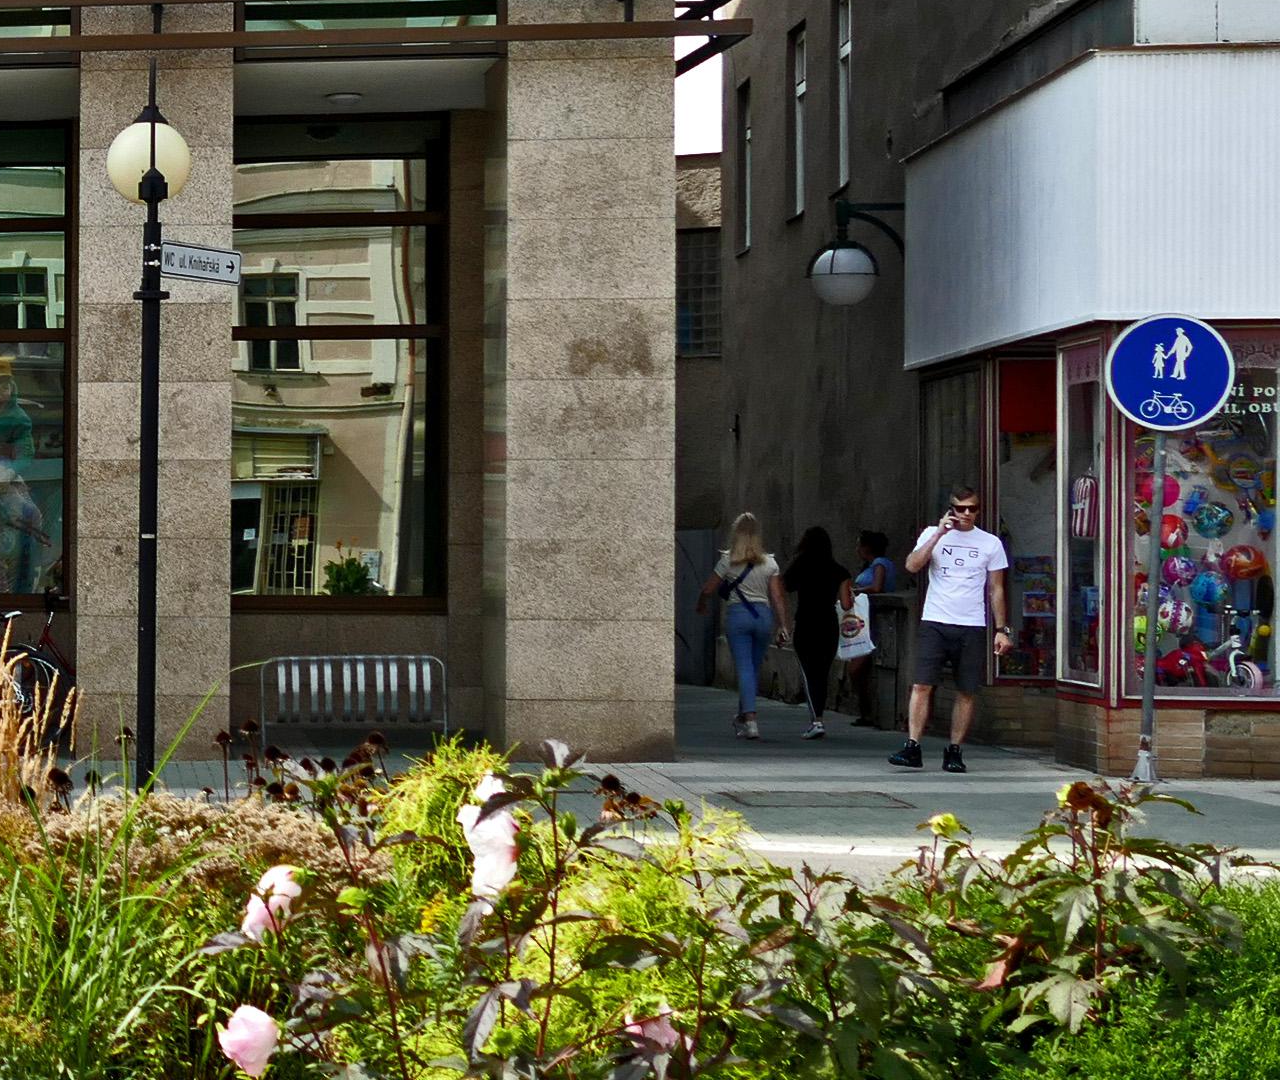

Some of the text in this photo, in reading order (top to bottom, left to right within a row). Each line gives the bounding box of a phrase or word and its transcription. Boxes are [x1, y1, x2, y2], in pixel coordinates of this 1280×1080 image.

[164, 251, 175, 267] WC
[942, 547, 952, 555] N
[955, 558, 964, 566] G
